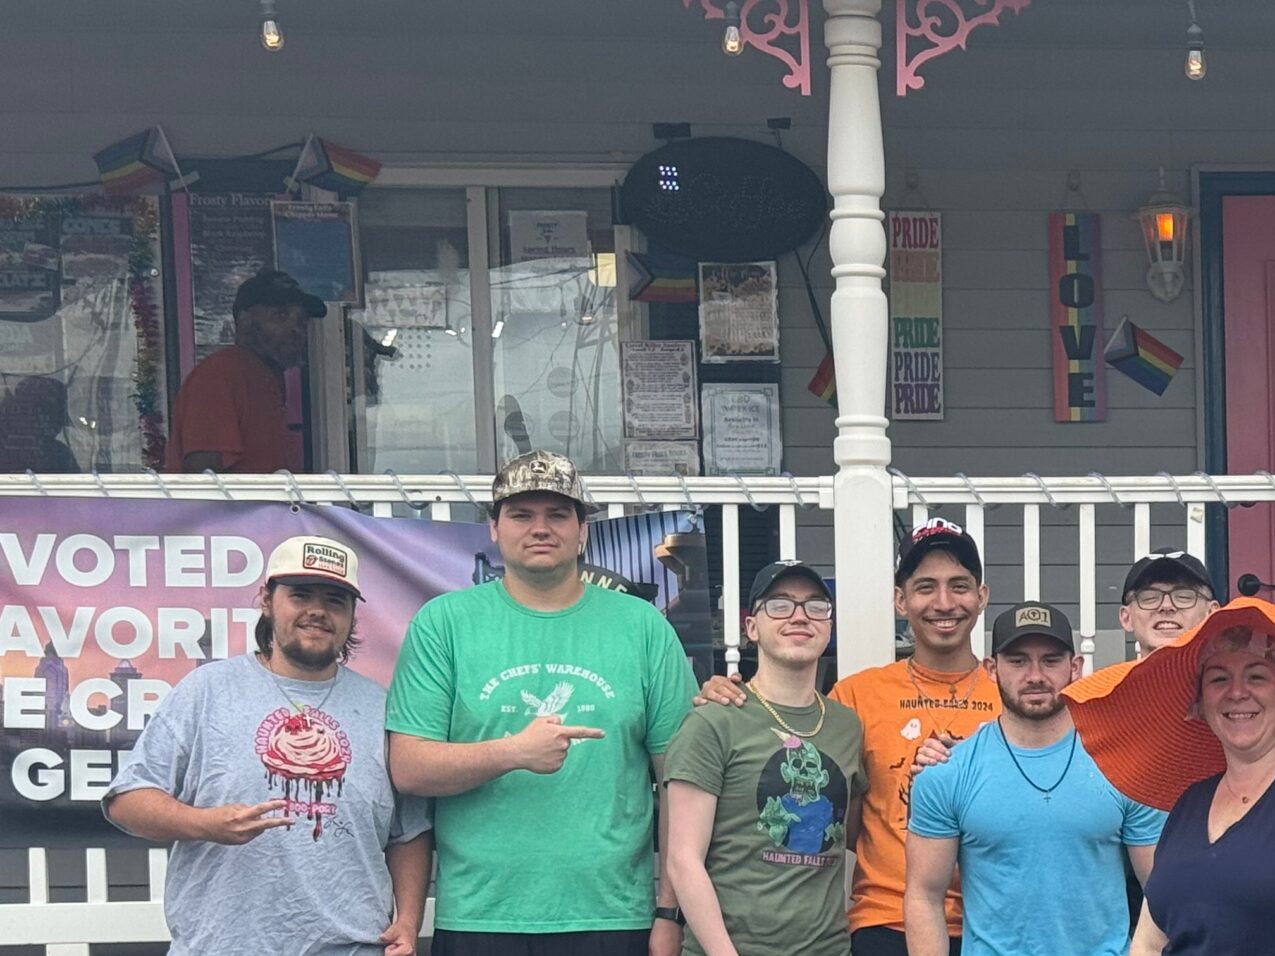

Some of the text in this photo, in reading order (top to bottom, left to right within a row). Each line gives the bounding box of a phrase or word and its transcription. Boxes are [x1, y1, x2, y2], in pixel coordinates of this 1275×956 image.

[189, 192, 227, 208] Frosty
[892, 217, 939, 249] PRIDE
[1059, 224, 1097, 408] LOVE
[893, 317, 941, 349] PRIDE
[894, 351, 941, 382] PRIDE
[894, 383, 942, 414] PRIDE
[0, 532, 264, 588] VOTED
[307, 545, 345, 563] Rolling
[479, 677, 500, 701] THE
[545, 663, 616, 699] WAREHOUSE
[501, 704, 518, 713] EST.
[899, 699, 940, 709] HAUNTED
[971, 700, 993, 712] 2024
[254, 707, 291, 754] HAUNTED
[762, 852, 801, 865] HAUNTED
